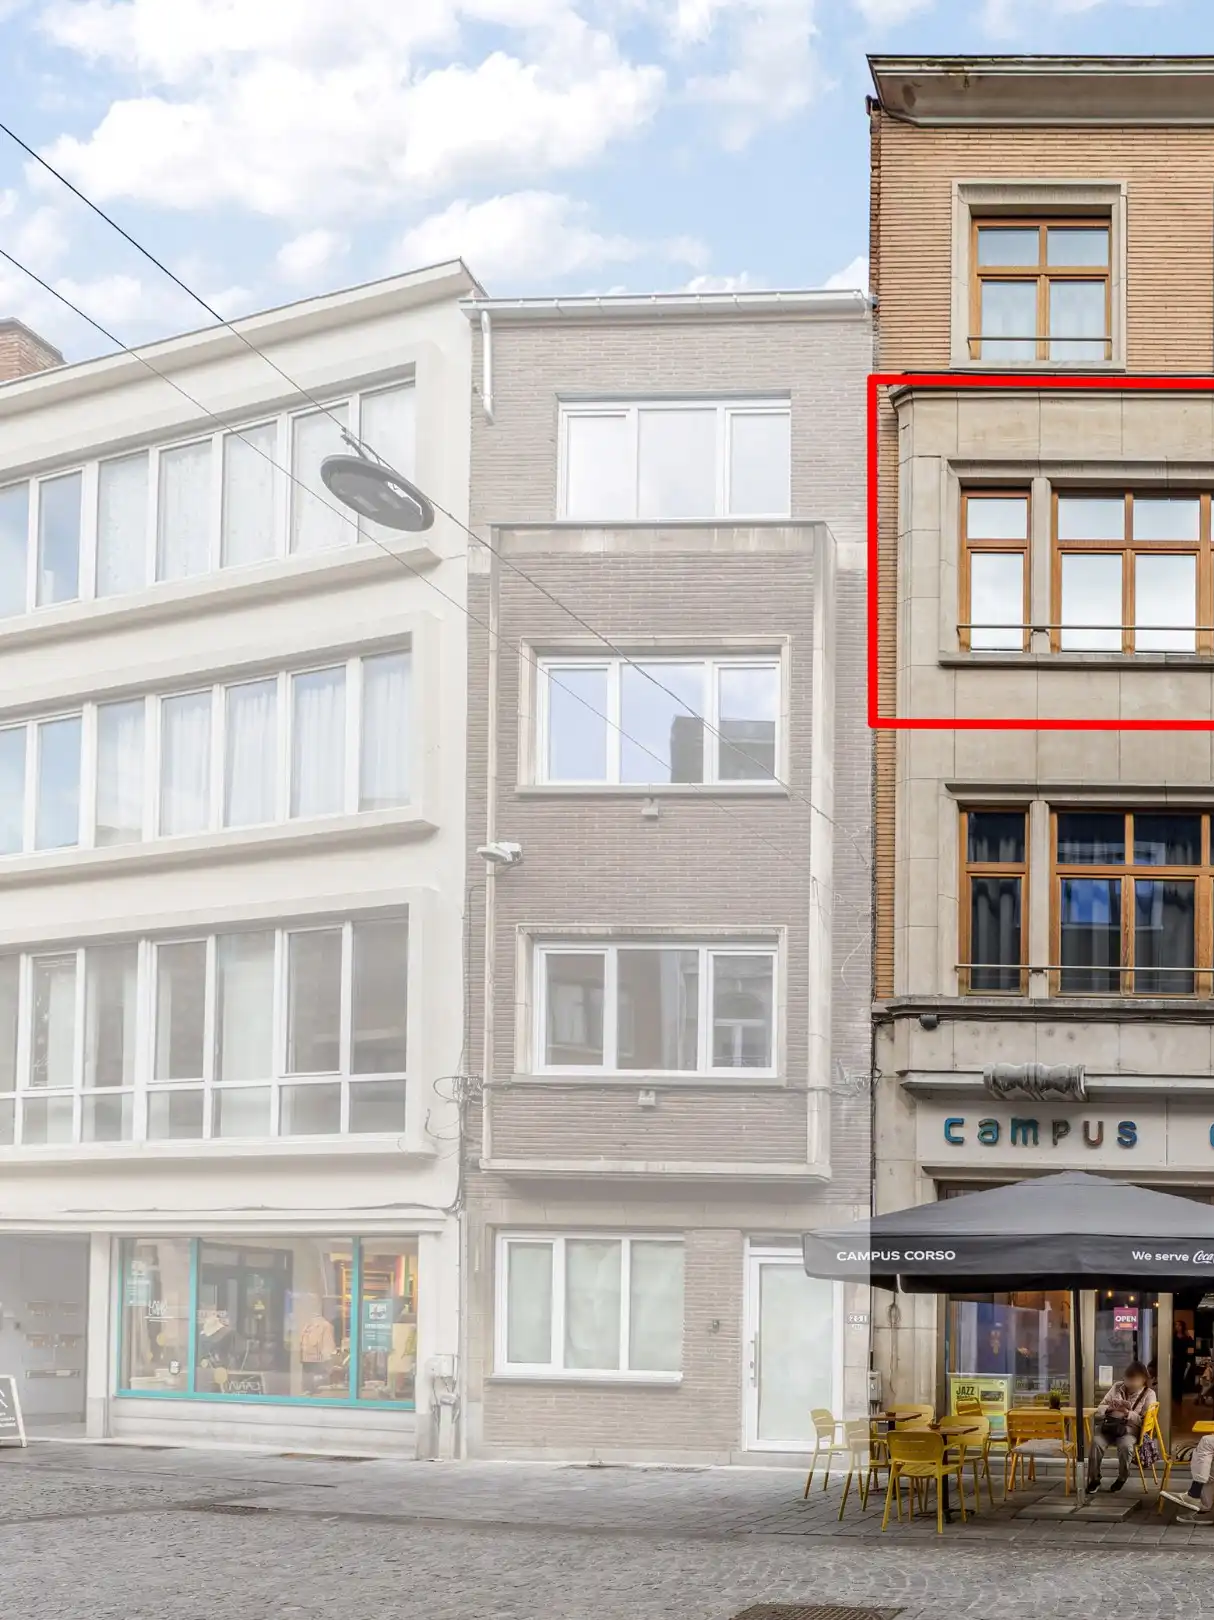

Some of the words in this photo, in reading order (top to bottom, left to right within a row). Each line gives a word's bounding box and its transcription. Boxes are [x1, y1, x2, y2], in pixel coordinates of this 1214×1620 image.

[836, 1250, 901, 1261] CAMPUS
[904, 1250, 956, 1261] CORSO
[1131, 1251, 1152, 1261] We
[1155, 1252, 1190, 1262] serve
[1115, 1315, 1137, 1323] OPEN
[956, 1386, 975, 1396] JAZZ
